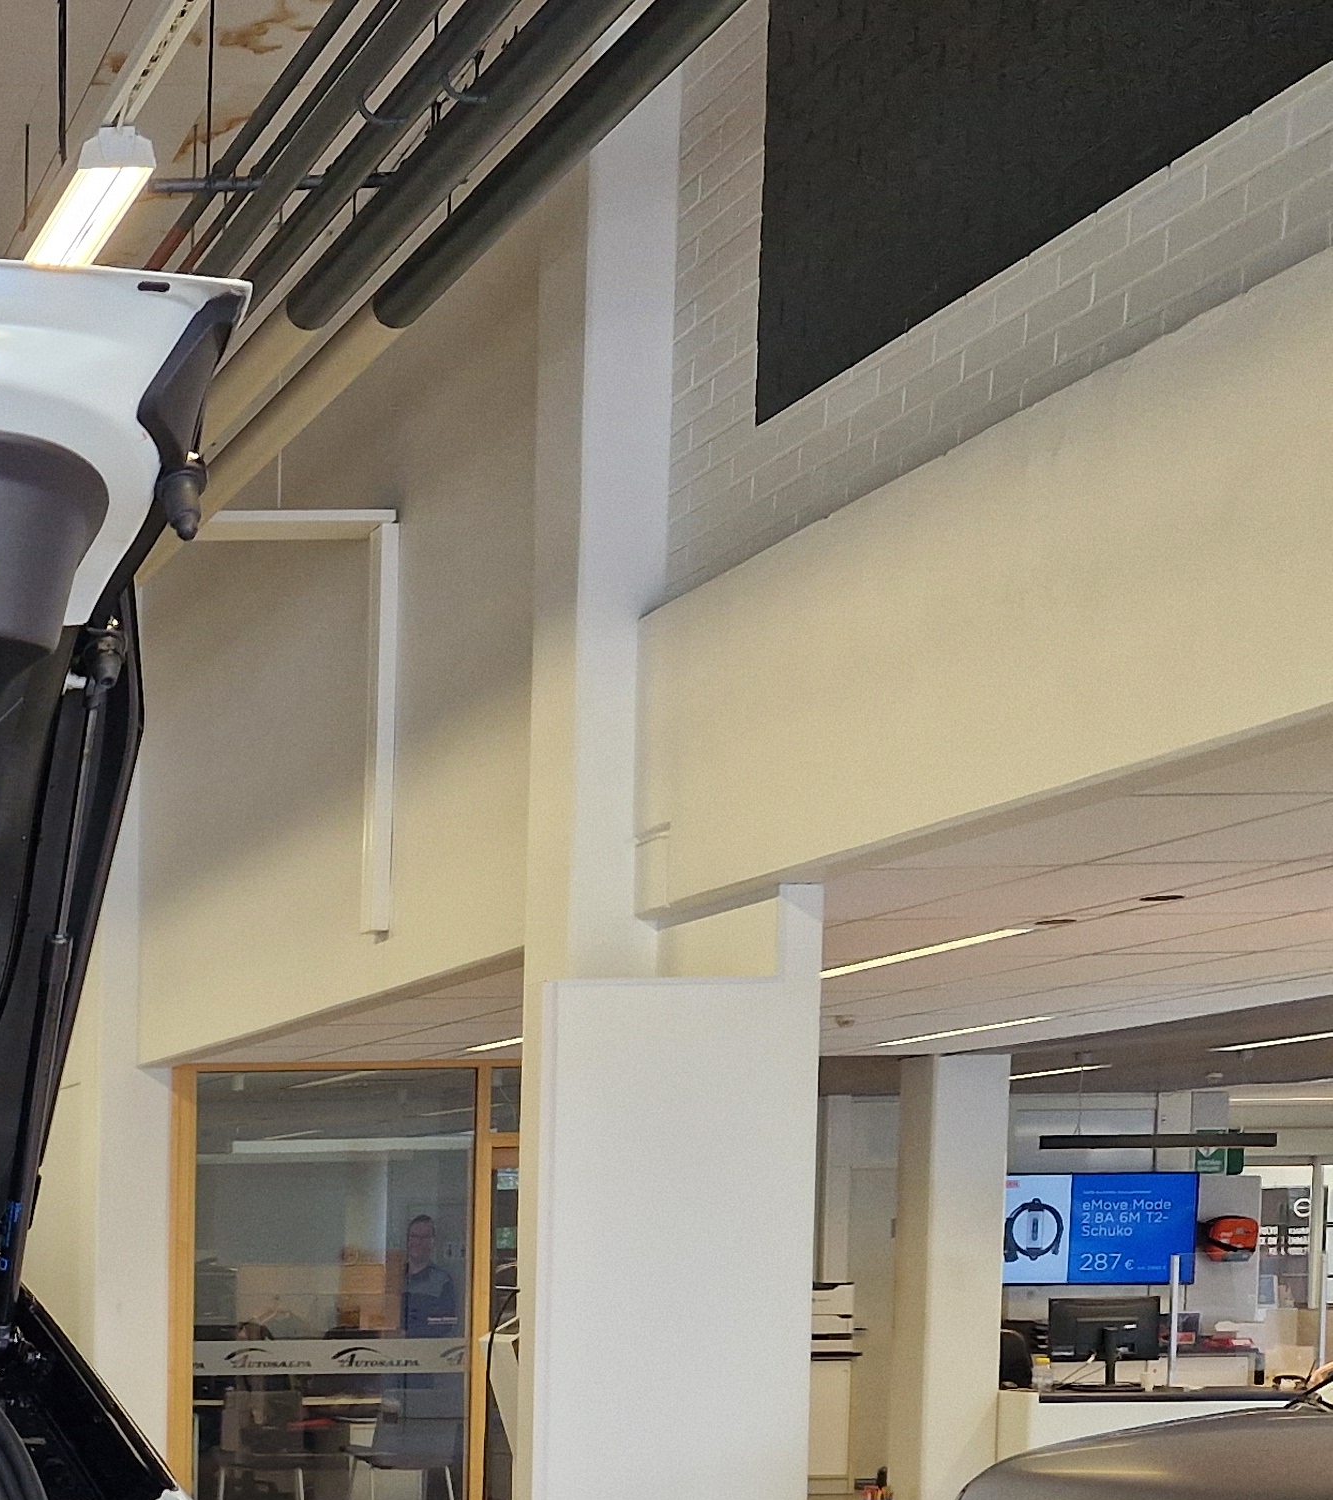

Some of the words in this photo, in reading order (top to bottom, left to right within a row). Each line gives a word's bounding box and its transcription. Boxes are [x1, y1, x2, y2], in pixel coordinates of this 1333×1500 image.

[1082, 1199, 1129, 1211] eMove
[1132, 1198, 1172, 1210] Mode
[1081, 1211, 1091, 1224] 2
[1094, 1212, 1115, 1224] 8A
[1119, 1211, 1141, 1223] 6M
[1146, 1211, 1169, 1223] T2-
[1081, 1224, 1133, 1237] Schuko
[1079, 1253, 1122, 1271] 287
[1124, 1259, 1135, 1271] €
